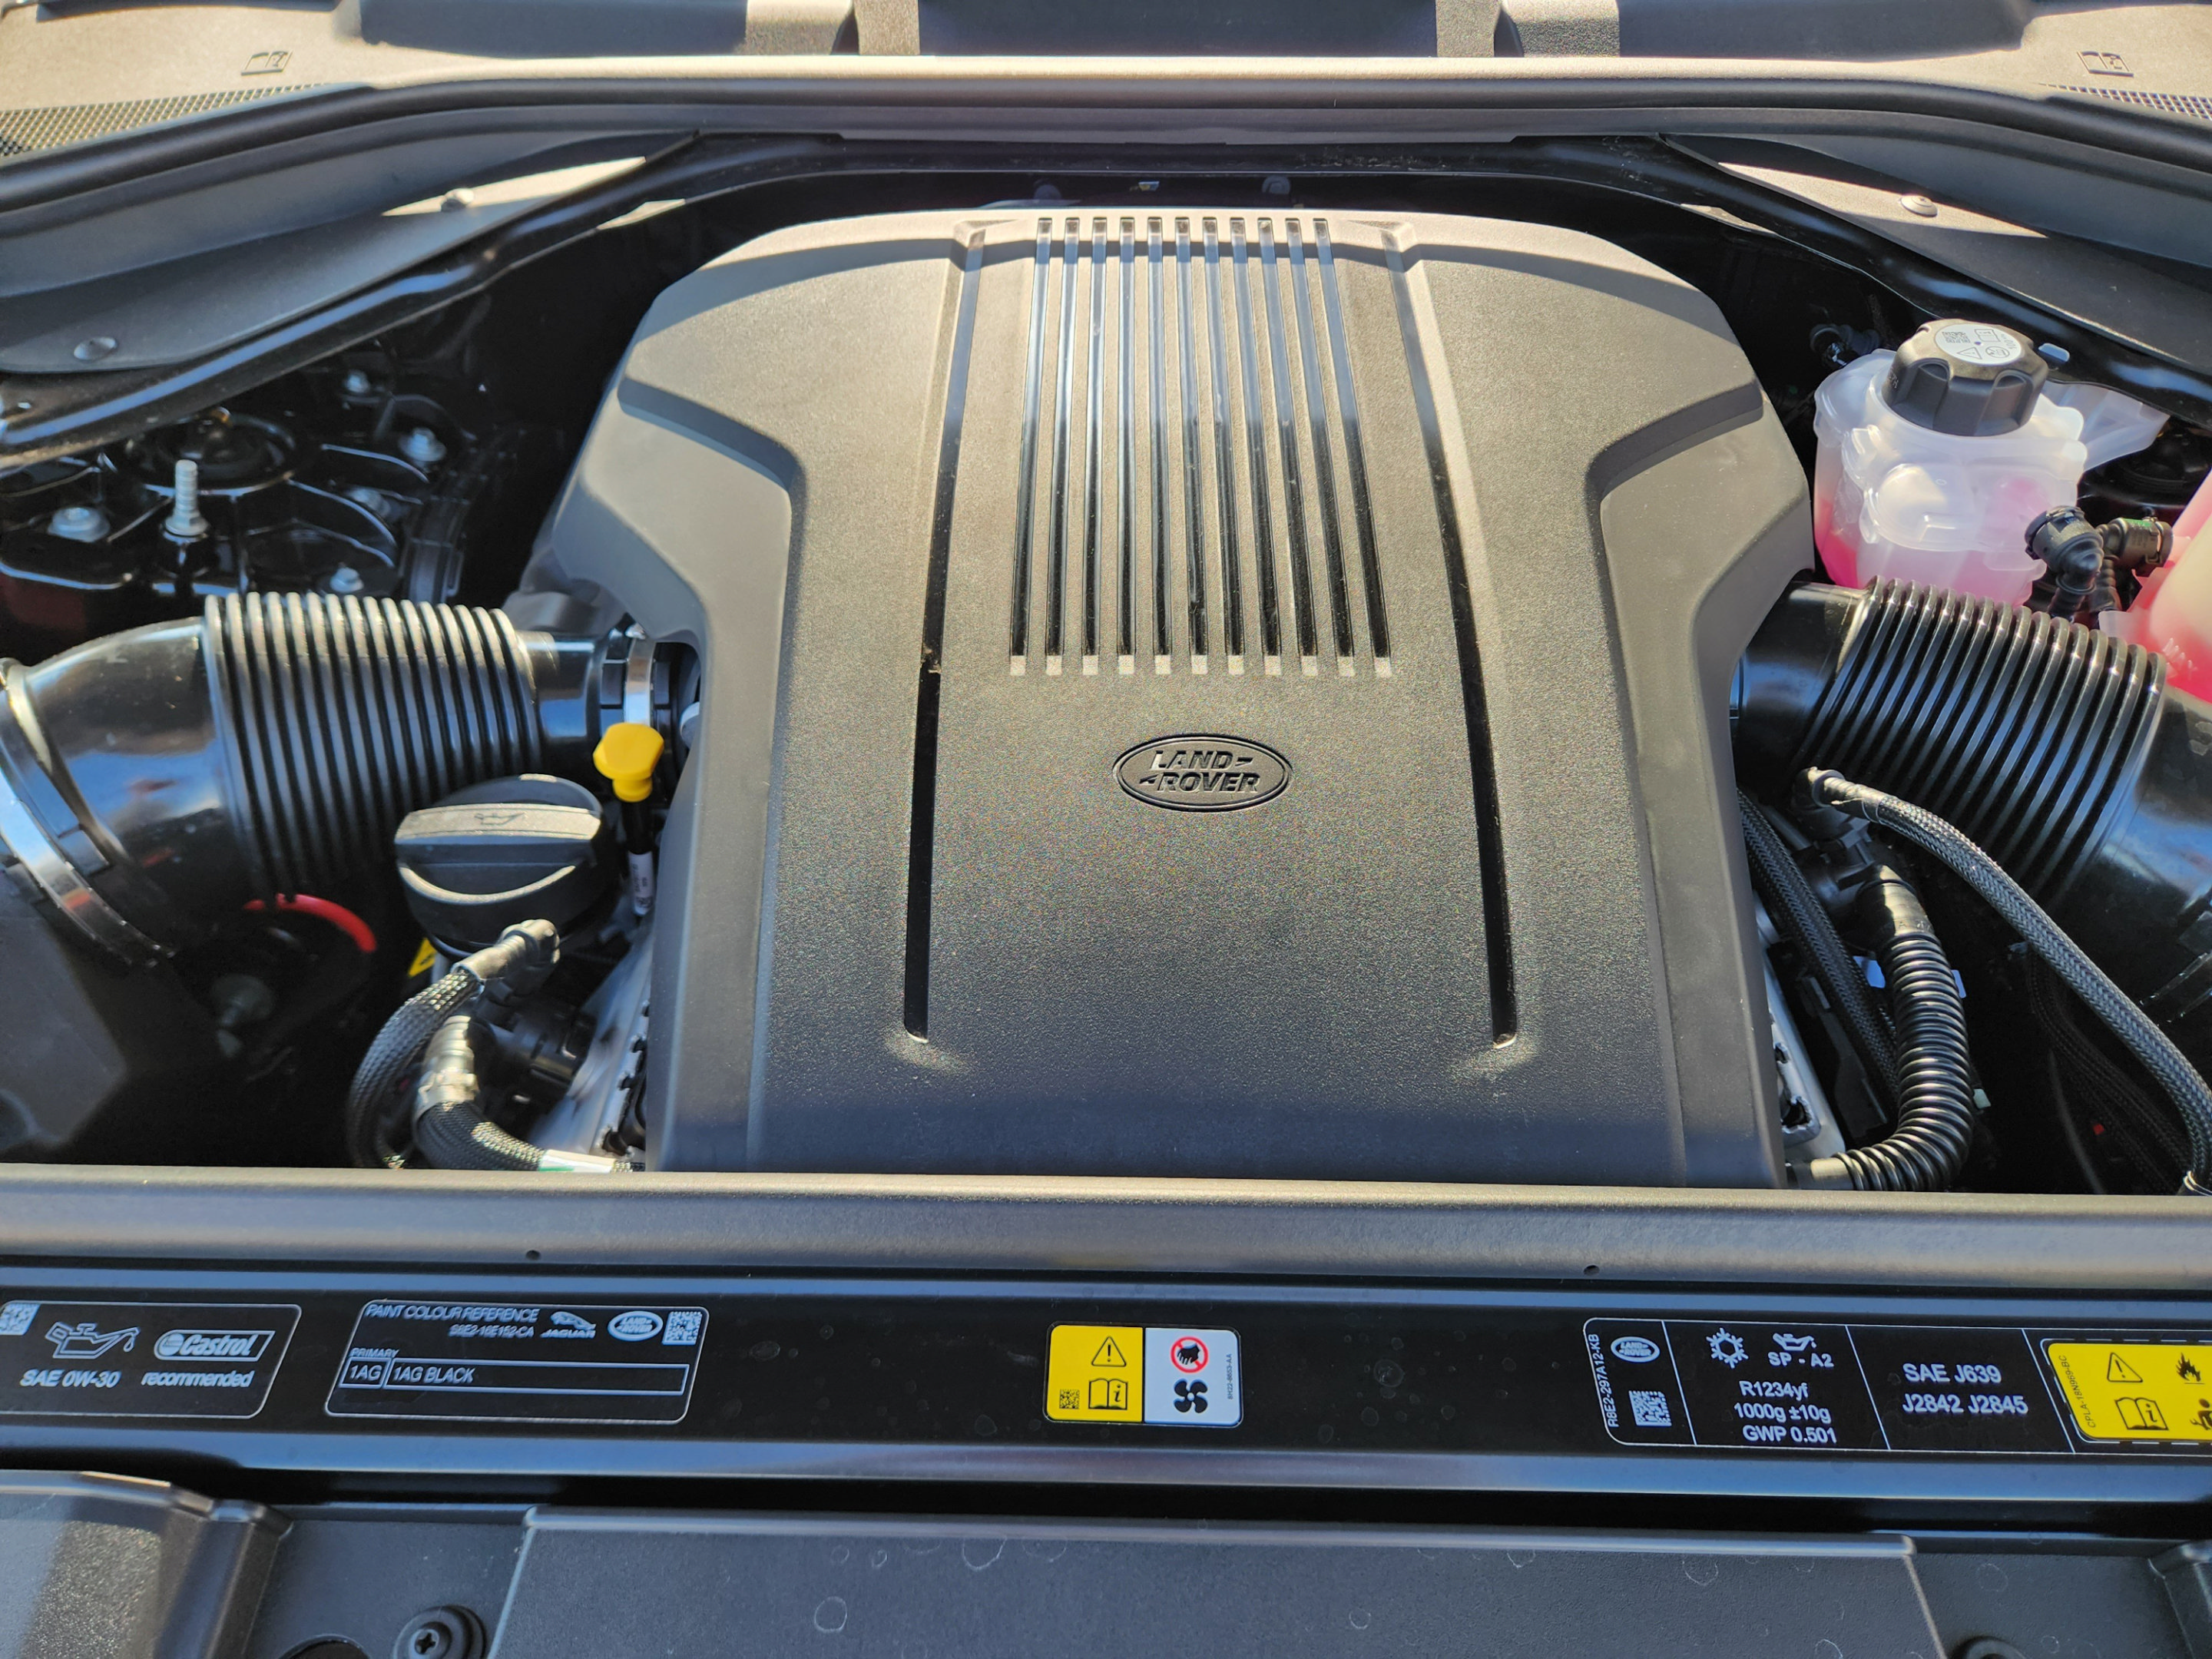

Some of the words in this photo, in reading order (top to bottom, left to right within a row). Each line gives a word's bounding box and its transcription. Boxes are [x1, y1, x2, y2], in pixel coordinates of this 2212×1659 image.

[365, 1304, 405, 1318] PAINT
[402, 1306, 462, 1320] COLOUR
[461, 1307, 540, 1323] REFERENCE
[540, 1330, 596, 1339] JAGUAR
[179, 1333, 259, 1356] Castrol
[349, 1348, 399, 1358] PRIMARY
[1768, 1352, 1792, 1366] SP
[1810, 1353, 1834, 1368] A2
[20, 1369, 65, 1388] SAE
[62, 1370, 121, 1389] 0W-30
[141, 1370, 255, 1388] recommended
[348, 1365, 382, 1382] 1AG
[393, 1366, 424, 1382] 1AG
[423, 1367, 475, 1384] BLACK
[1902, 1363, 1950, 1383] SAE
[1953, 1364, 2002, 1384] J639
[1739, 1380, 1808, 1401] R1234yf
[2058, 1355, 2096, 1429] CPLA-18N969-BC
[1734, 1402, 1786, 1423] 1000g
[1788, 1404, 1832, 1425] ±10g
[1902, 1393, 1964, 1414] J2842
[1967, 1394, 2028, 1415] J2845
[1743, 1425, 1786, 1442] GWP
[1790, 1426, 1837, 1444] 0.501
